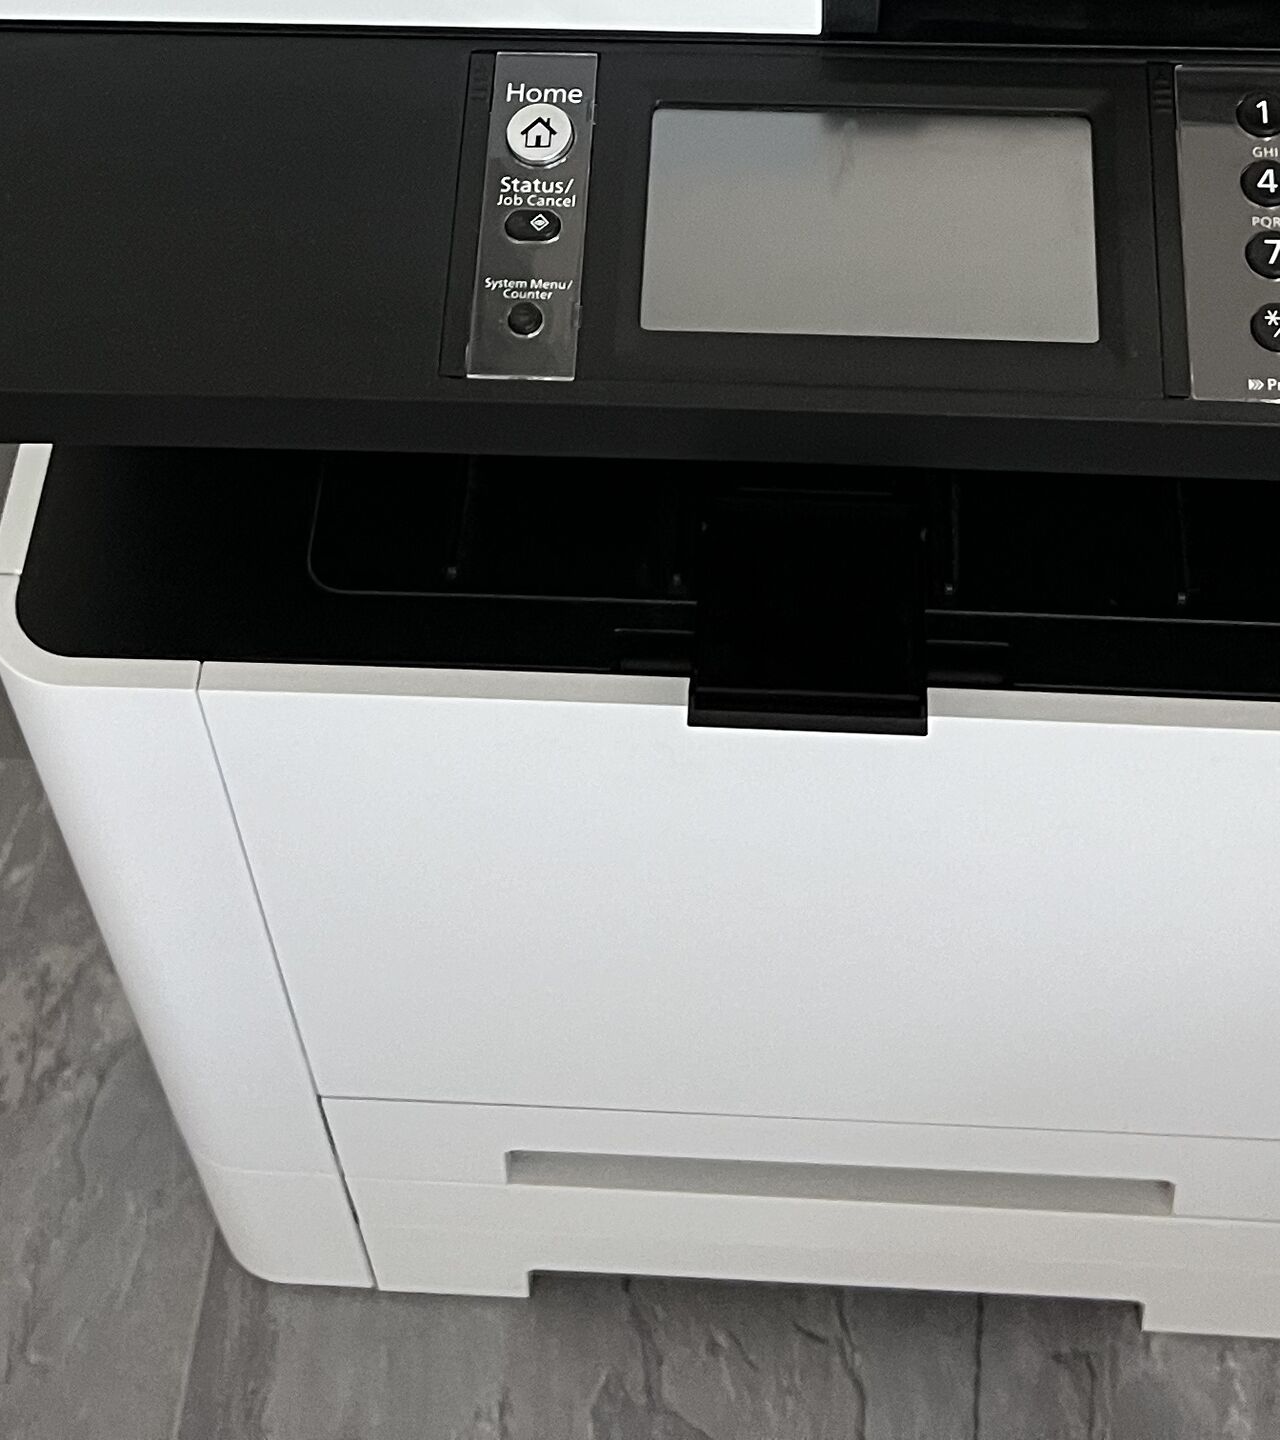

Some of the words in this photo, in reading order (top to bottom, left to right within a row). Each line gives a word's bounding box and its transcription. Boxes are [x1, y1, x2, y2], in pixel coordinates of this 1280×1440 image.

[506, 82, 584, 105] Home
[1255, 100, 1269, 125] 1
[1252, 146, 1279, 158] GHI
[500, 176, 575, 195] Status/
[1256, 168, 1279, 194] 4
[496, 194, 523, 208] Job
[526, 194, 577, 208] Cancel
[484, 276, 528, 291] System
[530, 278, 573, 291] Menu/
[503, 289, 553, 301] Counter
